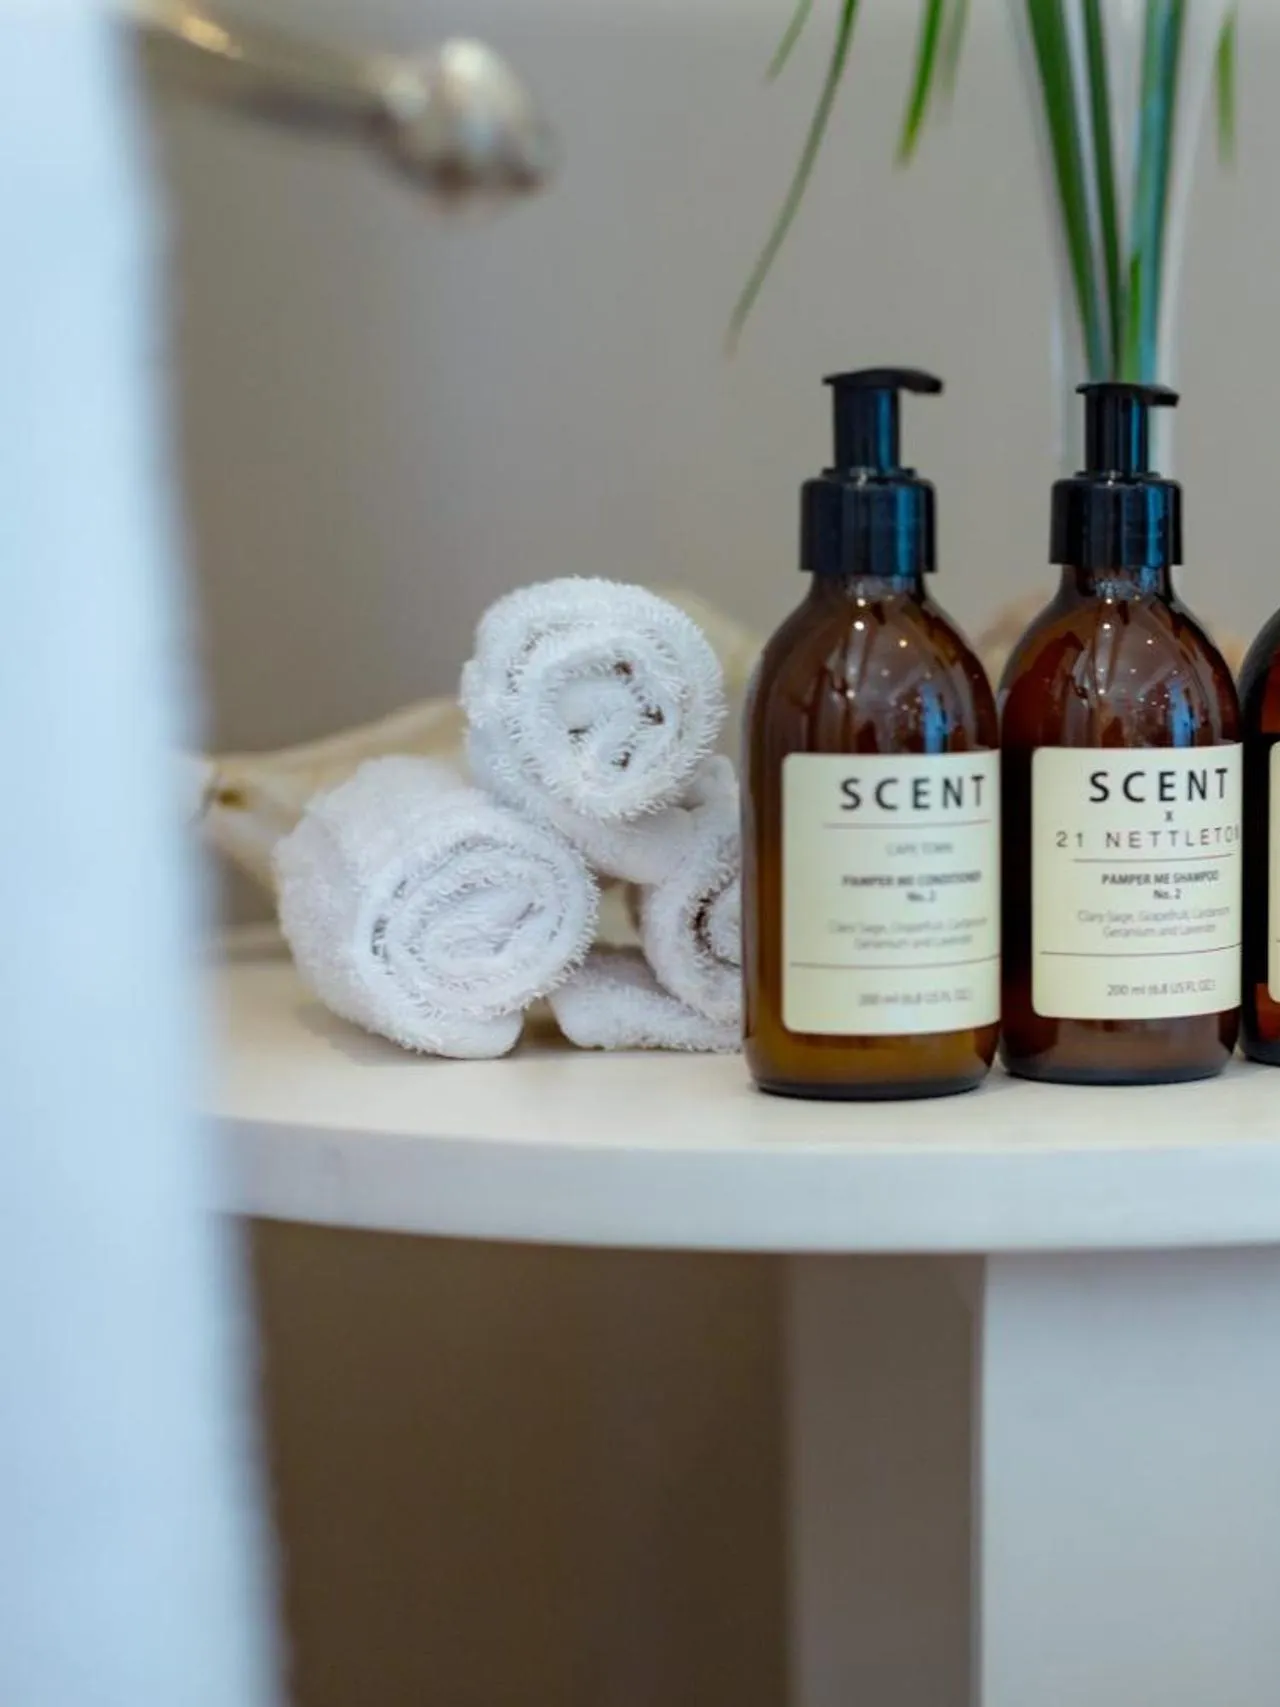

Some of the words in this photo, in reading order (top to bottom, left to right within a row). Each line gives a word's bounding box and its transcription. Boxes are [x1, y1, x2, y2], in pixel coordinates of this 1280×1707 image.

[840, 775, 985, 811] SCENT
[1089, 768, 1228, 803] SCENT
[1056, 831, 1084, 848] 21
[841, 873, 893, 887] PAMPER
[1101, 873, 1151, 885] PAMPER
[1153, 872, 1170, 884] ME
[1172, 869, 1219, 883] SHAMPOO
